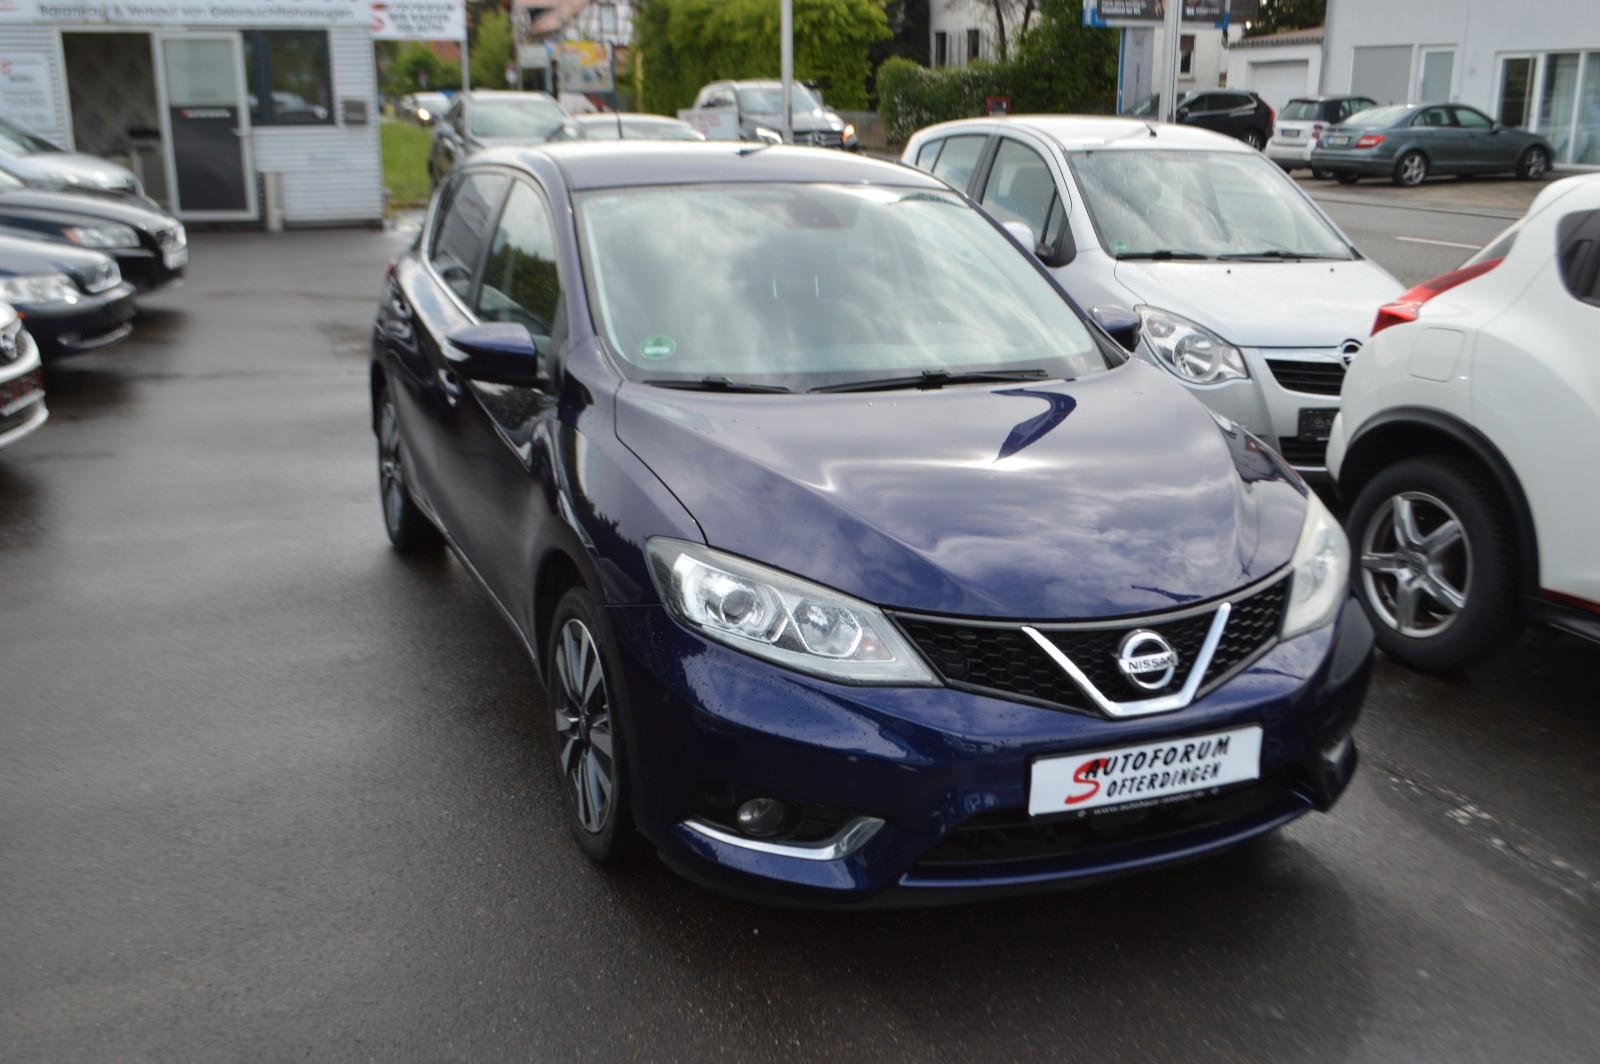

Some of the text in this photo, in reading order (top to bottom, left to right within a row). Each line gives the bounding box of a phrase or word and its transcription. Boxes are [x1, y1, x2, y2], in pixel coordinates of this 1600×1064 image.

[1128, 654, 1174, 670] NISSAN
[1085, 736, 1231, 780] AUTOFORUM
[1107, 762, 1222, 798] OFTERDINGEN
